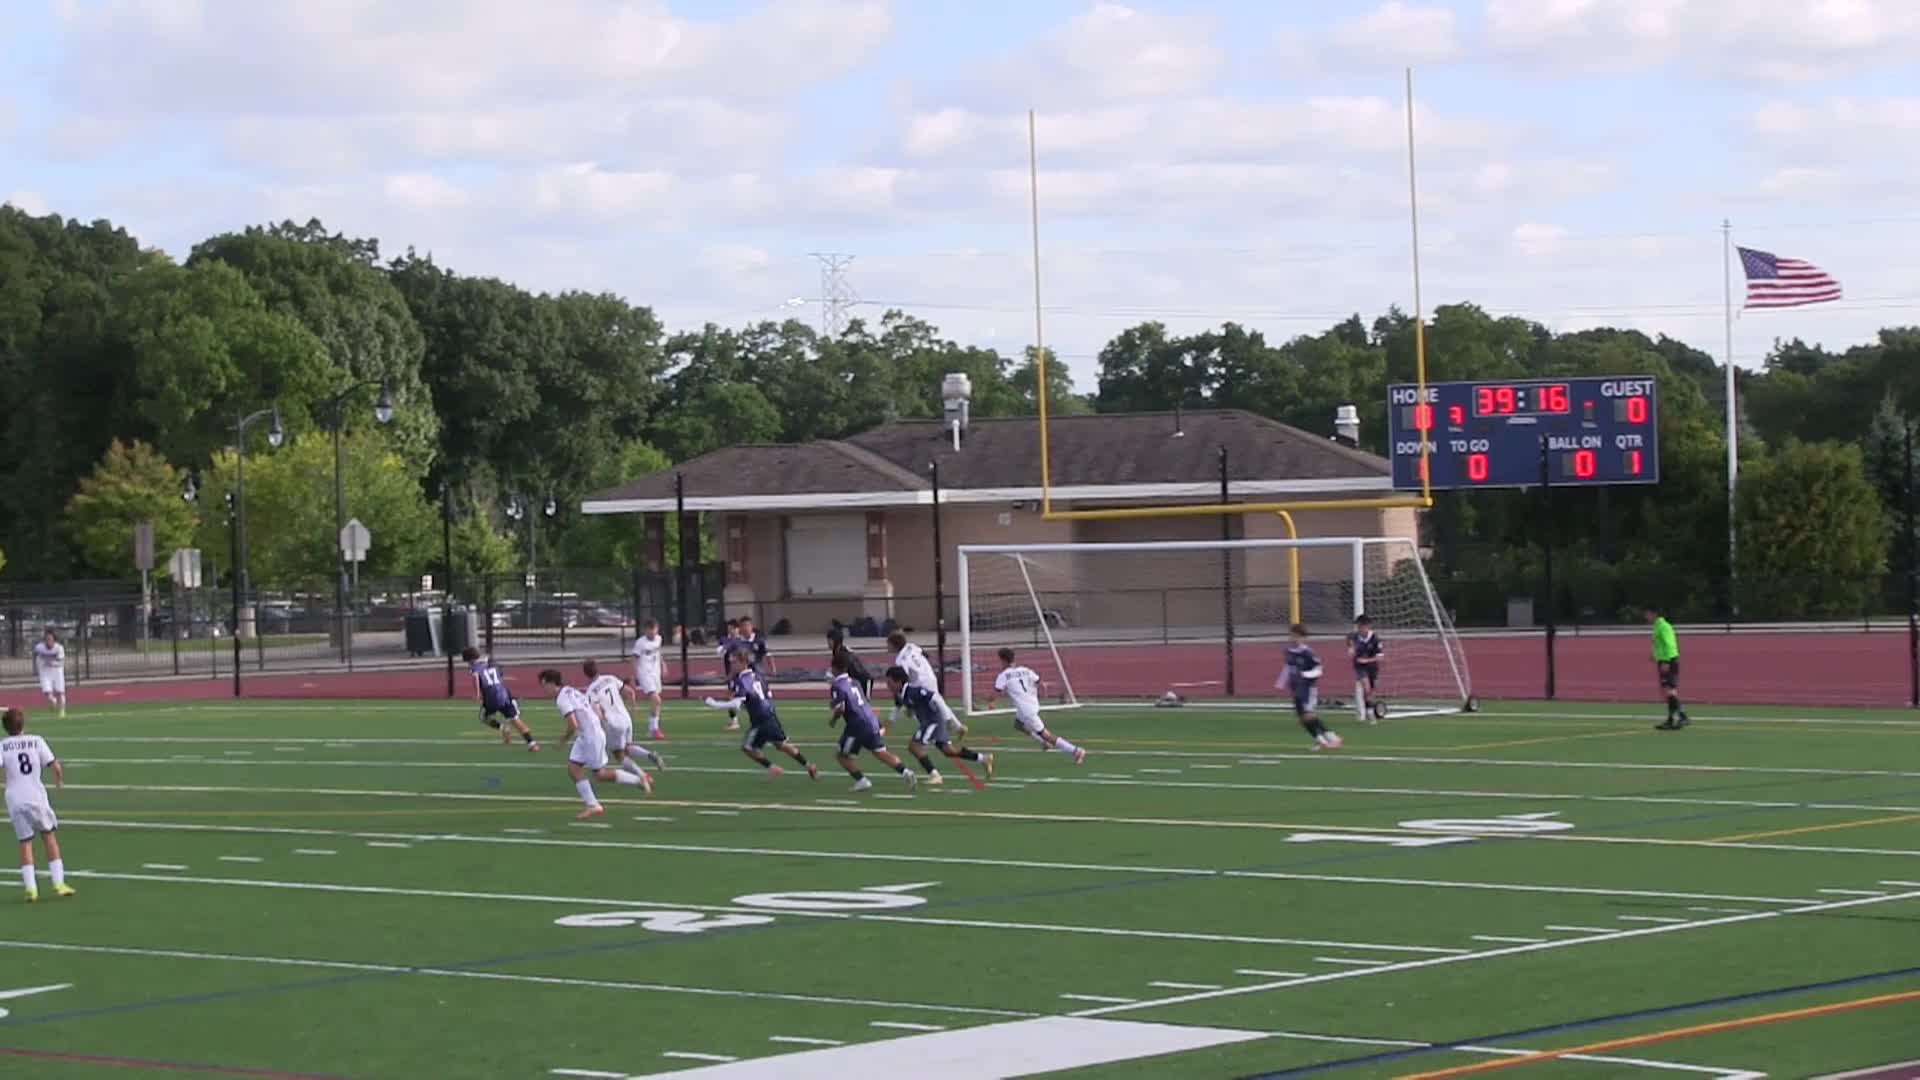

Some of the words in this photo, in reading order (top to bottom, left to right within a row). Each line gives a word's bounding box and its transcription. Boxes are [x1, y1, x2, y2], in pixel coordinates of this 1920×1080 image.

[1600, 381, 1654, 397] GUEST
[1477, 386, 1569, 415] 39:16
[1627, 397, 1648, 424] 0
[1396, 441, 1438, 454] DOWN
[1450, 440, 1468, 453] TO
[1469, 439, 1490, 453] GO
[1548, 437, 1580, 450] BALL
[1581, 436, 1602, 449] ON
[1616, 435, 1643, 449] QTR
[1468, 453, 1489, 481] 0
[1574, 450, 1595, 478] 0
[1631, 450, 1642, 476] 1
[483, 667, 500, 685] 17
[604, 687, 614, 706] 7
[17, 752, 33, 775] 8
[554, 891, 928, 933] 20
